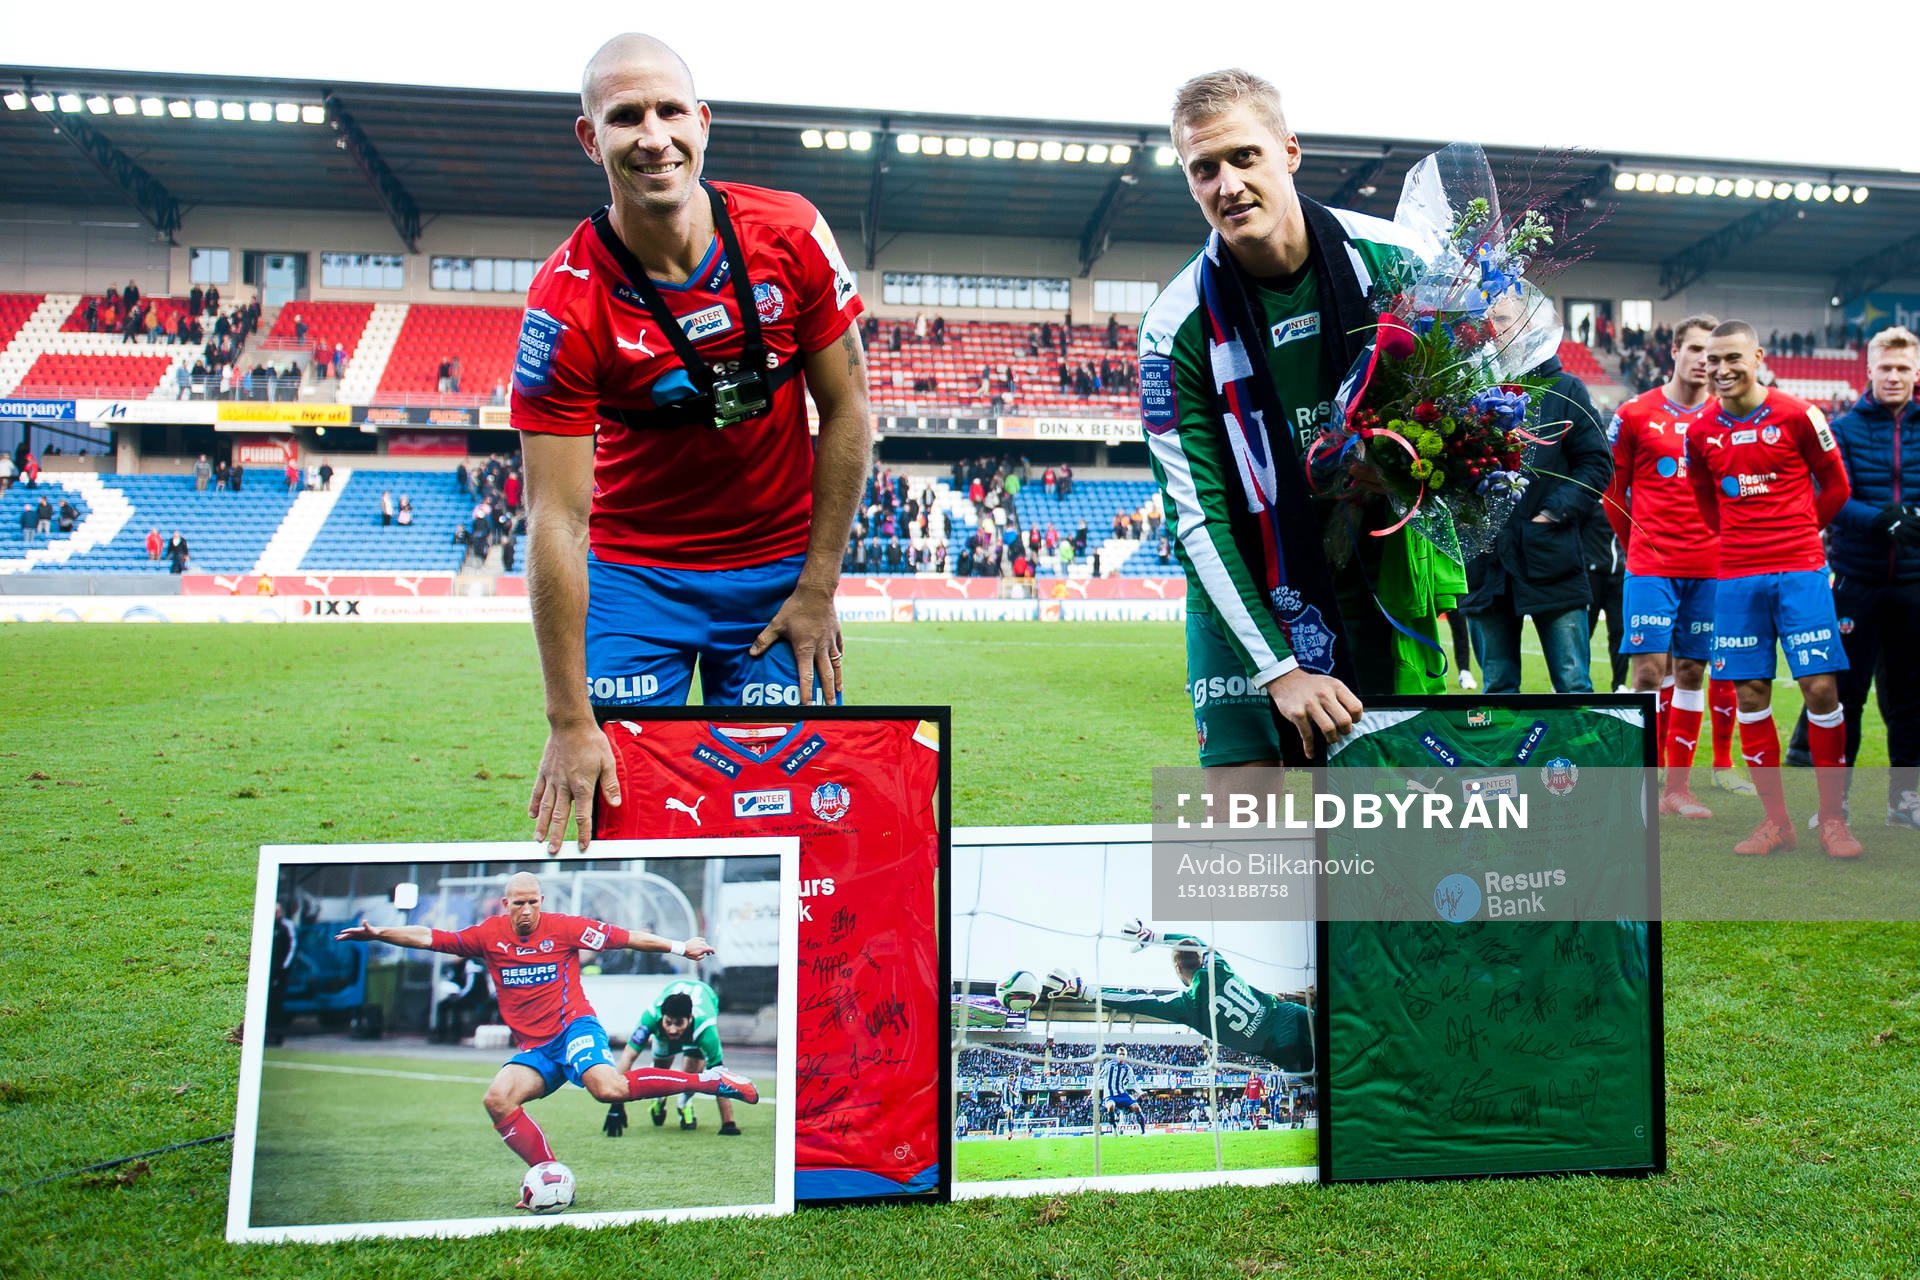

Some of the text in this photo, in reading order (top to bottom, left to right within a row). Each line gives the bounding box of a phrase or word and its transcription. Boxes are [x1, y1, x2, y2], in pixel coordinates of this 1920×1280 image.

[692, 310, 721, 327] INTER
[1289, 316, 1316, 329] INTER
[695, 319, 723, 334] SPORT
[1291, 325, 1316, 337] SPORT
[1145, 371, 1161, 379] HELA
[1740, 484, 1770, 497] Bank
[1640, 615, 1672, 627] SOLID
[1719, 636, 1758, 648] SOLID
[1792, 629, 1832, 645] SOLID
[1798, 649, 1809, 666] 18
[1484, 779, 1512, 788] INTER
[1553, 774, 1568, 784] HIF
[1486, 787, 1512, 797] SPORT
[757, 795, 786, 803] INTER
[757, 803, 785, 811] SPORT
[1484, 868, 1567, 894] Resurs
[1487, 891, 1546, 918] Bank
[501, 963, 557, 977] RESURS
[503, 976, 533, 985] BANK
[1214, 977, 1260, 1032] 30
